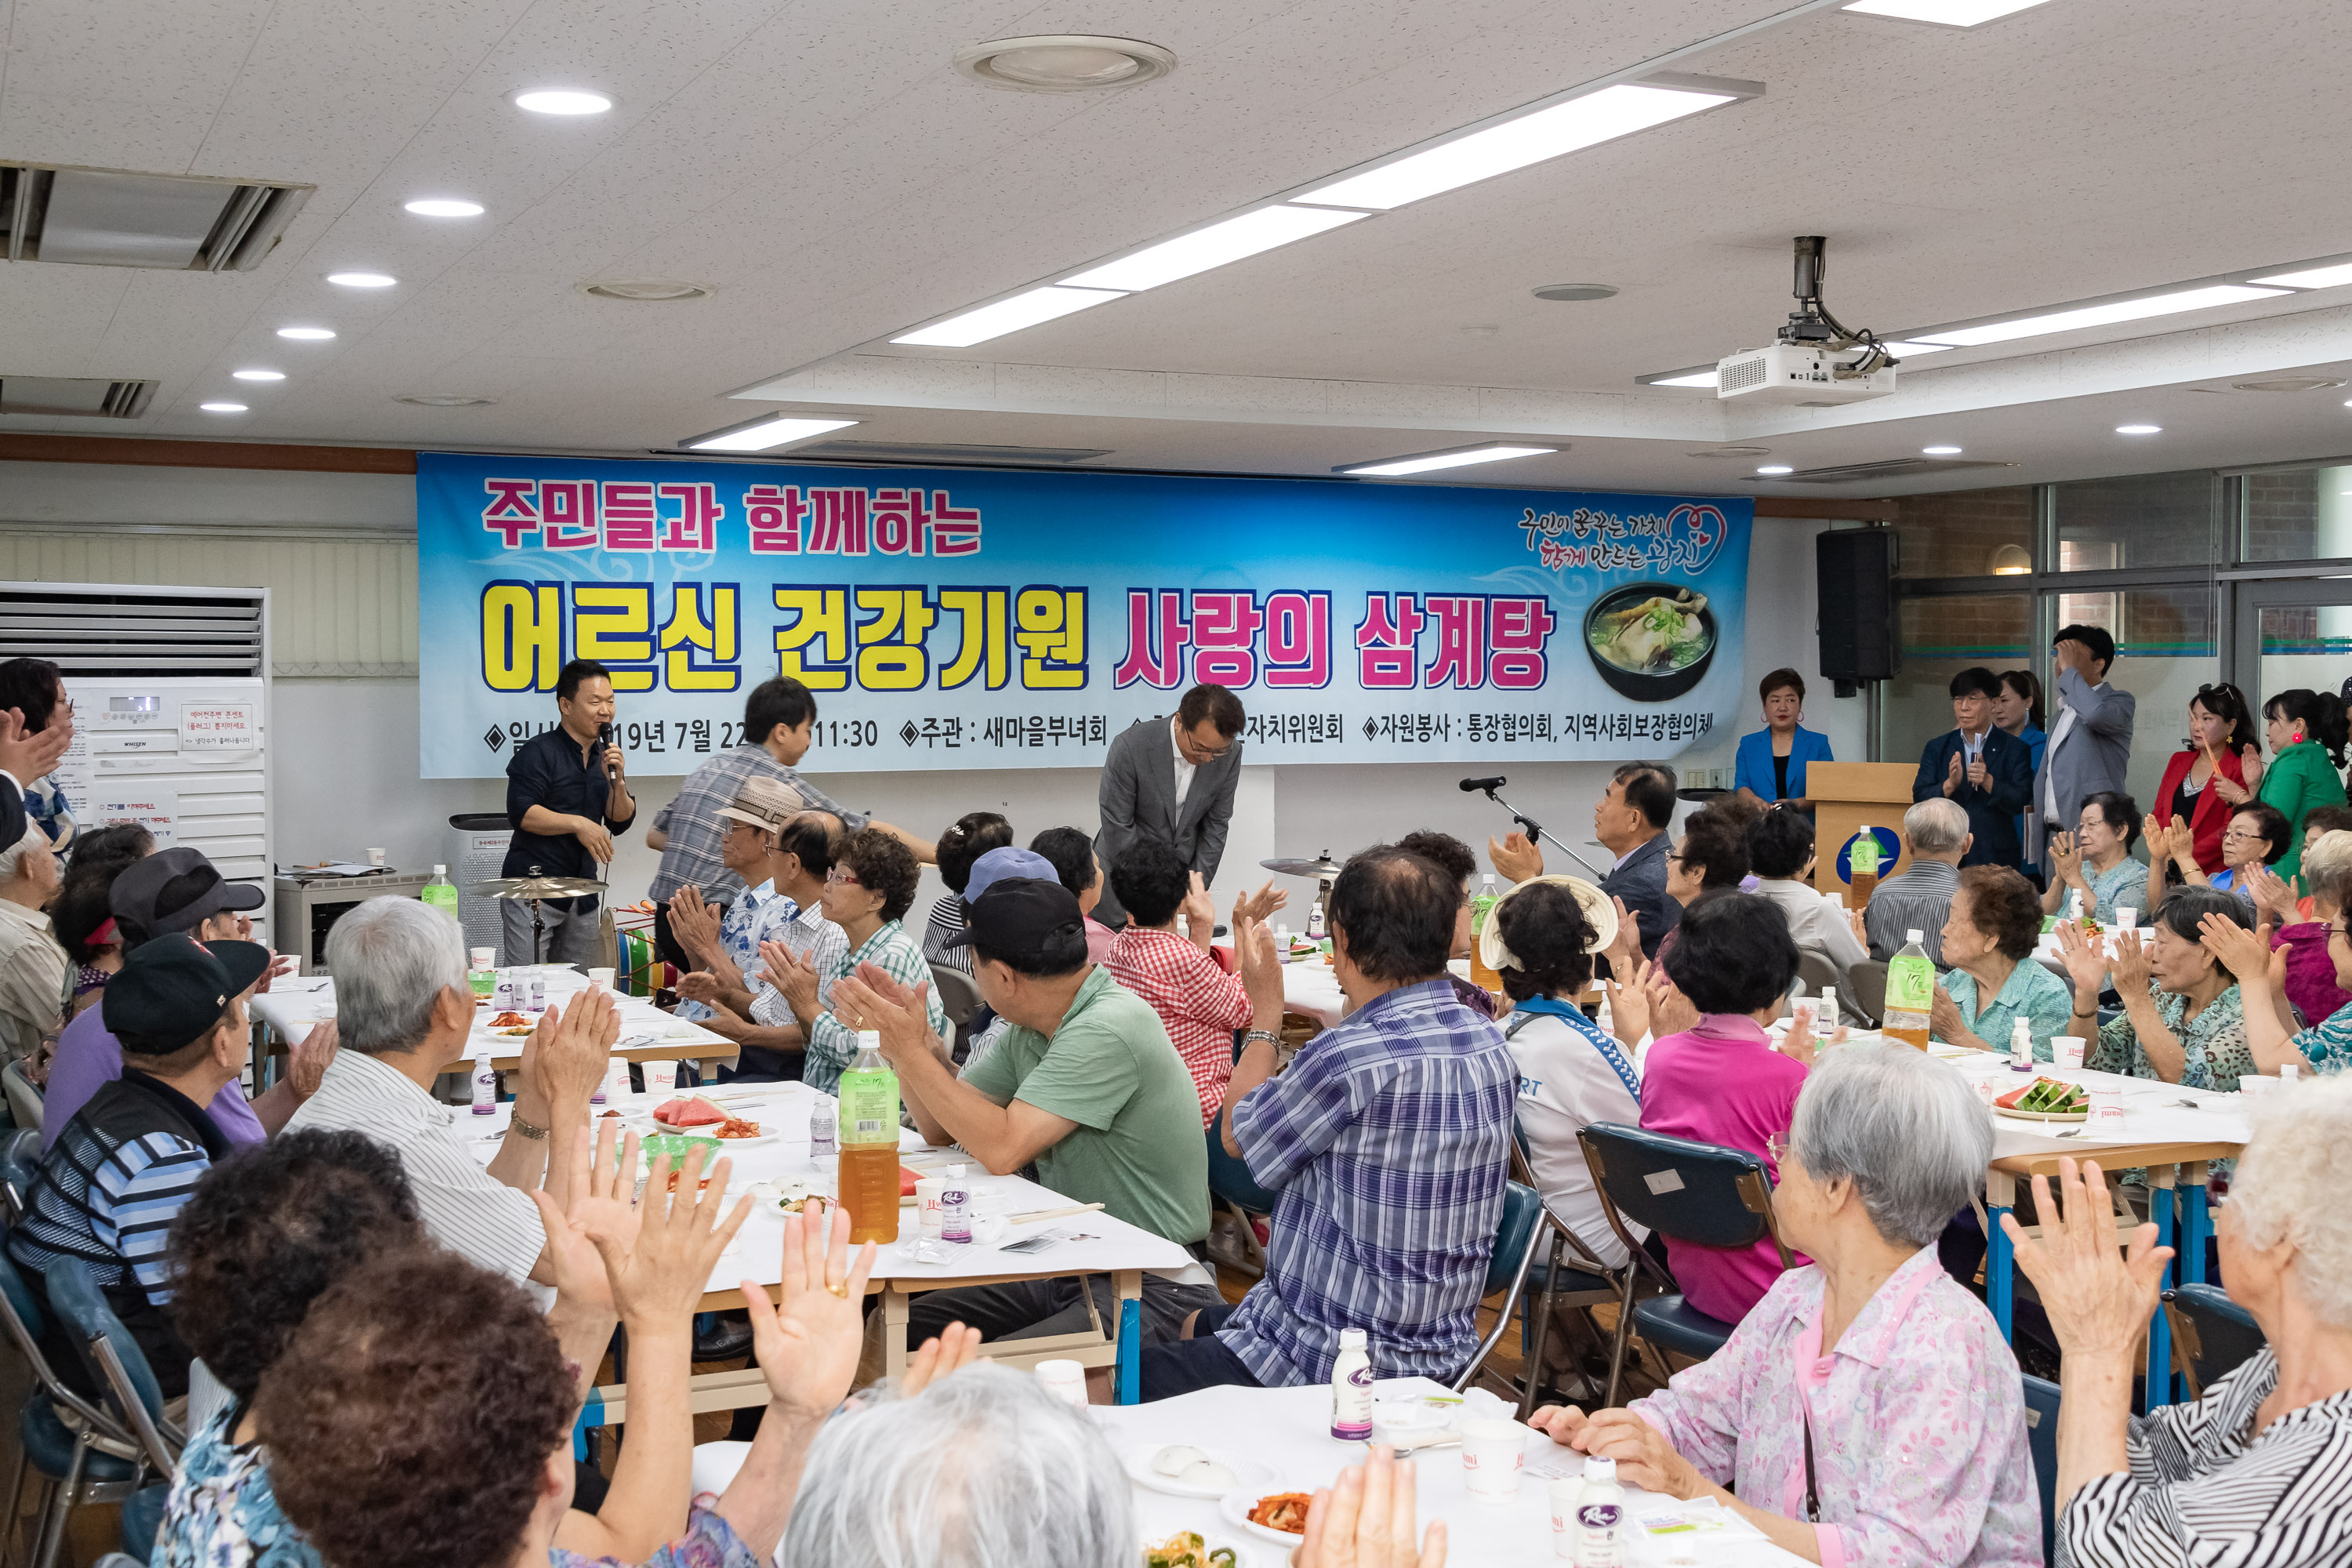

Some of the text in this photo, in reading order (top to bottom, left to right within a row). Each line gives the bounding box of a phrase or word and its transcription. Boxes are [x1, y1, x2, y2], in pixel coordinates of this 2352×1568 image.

[481, 477, 981, 557] 주민들과 함께하는
[1518, 507, 1664, 551] 구민이 꿈꾸는 가치
[1540, 535, 1703, 575] 함께 만드는 광진
[481, 579, 1555, 693] 어르신 건강기원 사랑의 삼계탕
[614, 720, 666, 753] 19년
[675, 719, 711, 753] 7월
[920, 717, 963, 749] 주관
[983, 715, 1107, 748] 새마을부녀회
[1380, 713, 1451, 743] 자원봉사
[1467, 713, 1558, 743] 통장협의회,
[1564, 712, 1713, 745] 지역사회보장협의체
[1519, 1076, 1543, 1097] RT
